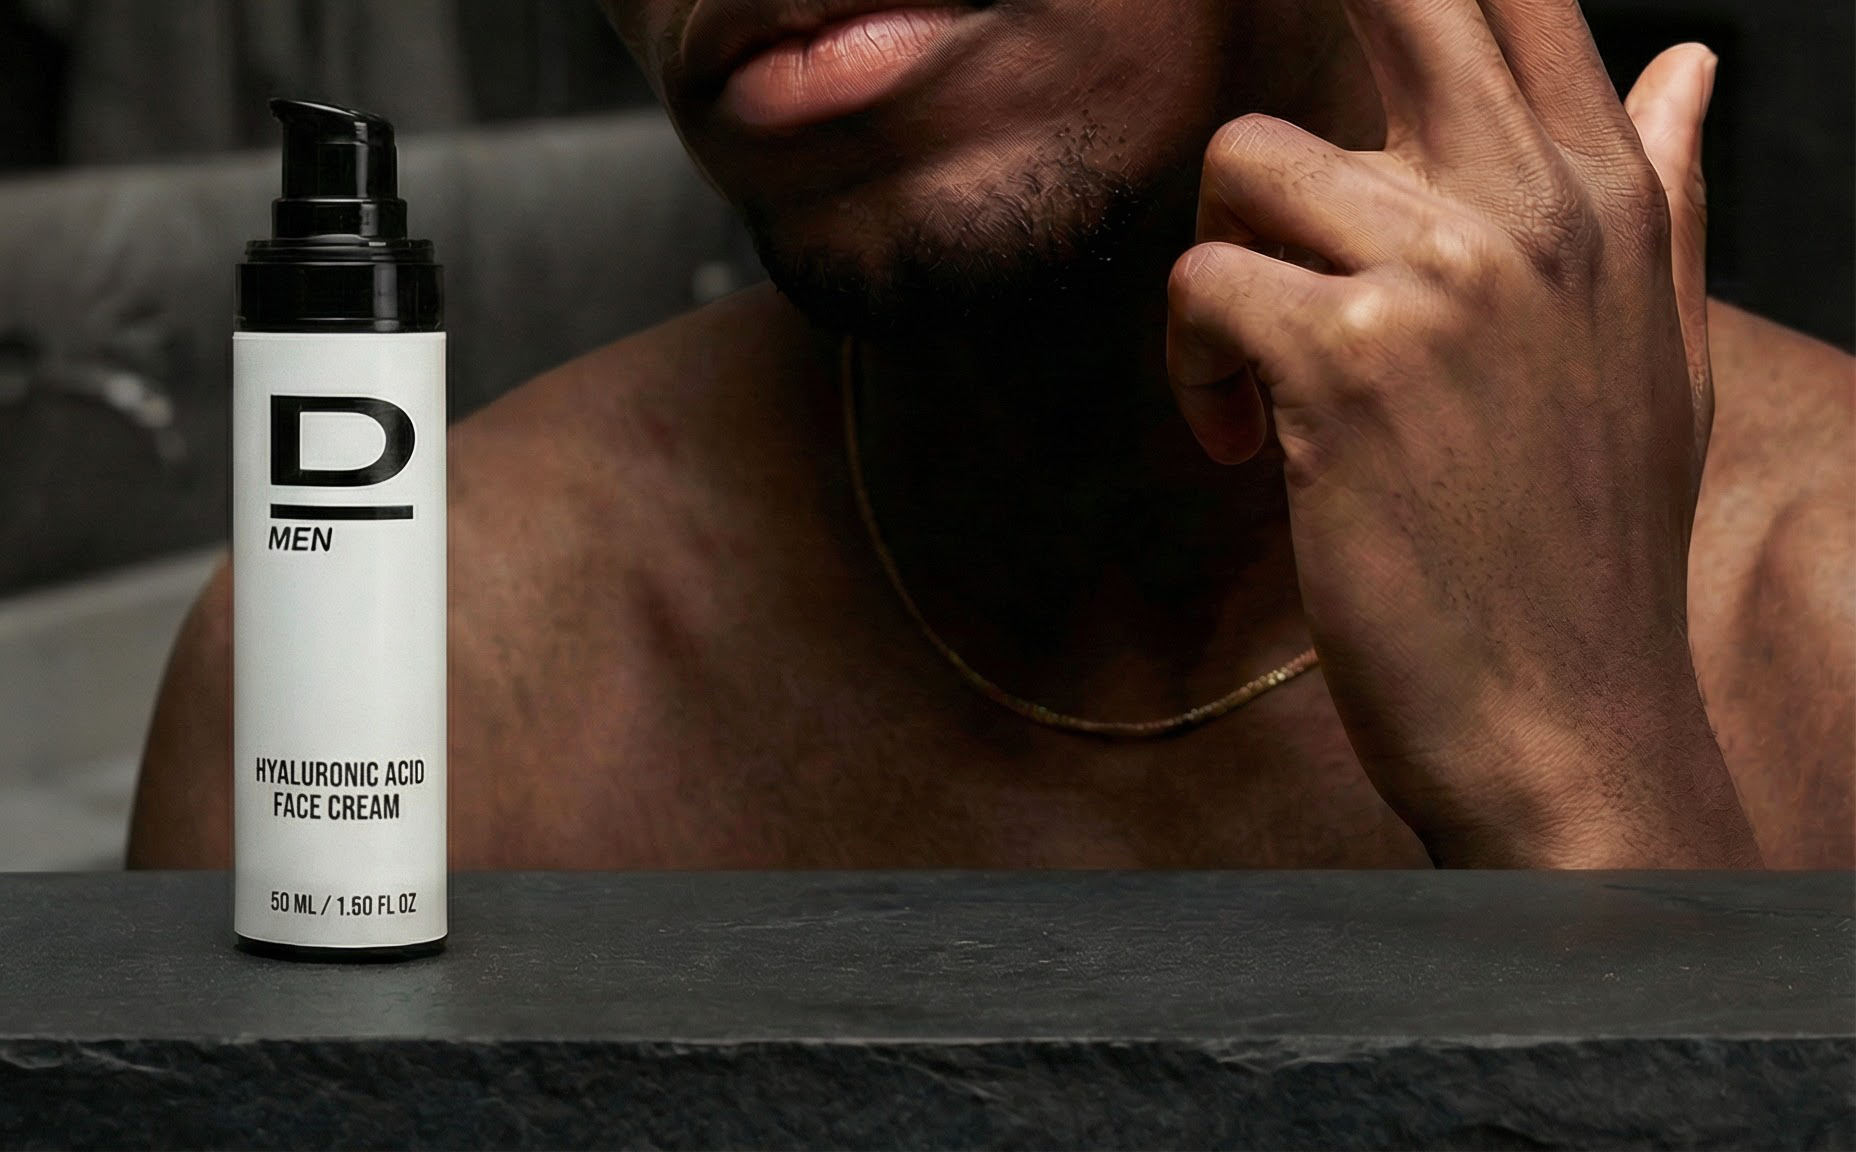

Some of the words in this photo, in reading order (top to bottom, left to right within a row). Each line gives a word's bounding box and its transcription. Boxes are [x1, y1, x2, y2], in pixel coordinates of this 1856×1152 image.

[271, 394, 416, 487] D
[268, 526, 333, 552] MEN
[256, 757, 379, 787] HYALURONIC
[384, 759, 425, 786] ACID
[273, 791, 322, 820] FACE
[328, 793, 400, 820] CREAM
[271, 891, 290, 912] 50
[294, 893, 317, 915] ML
[320, 895, 332, 916] /
[336, 896, 373, 916] 1.50
[378, 895, 395, 915] FL
[398, 892, 417, 913] OZ
